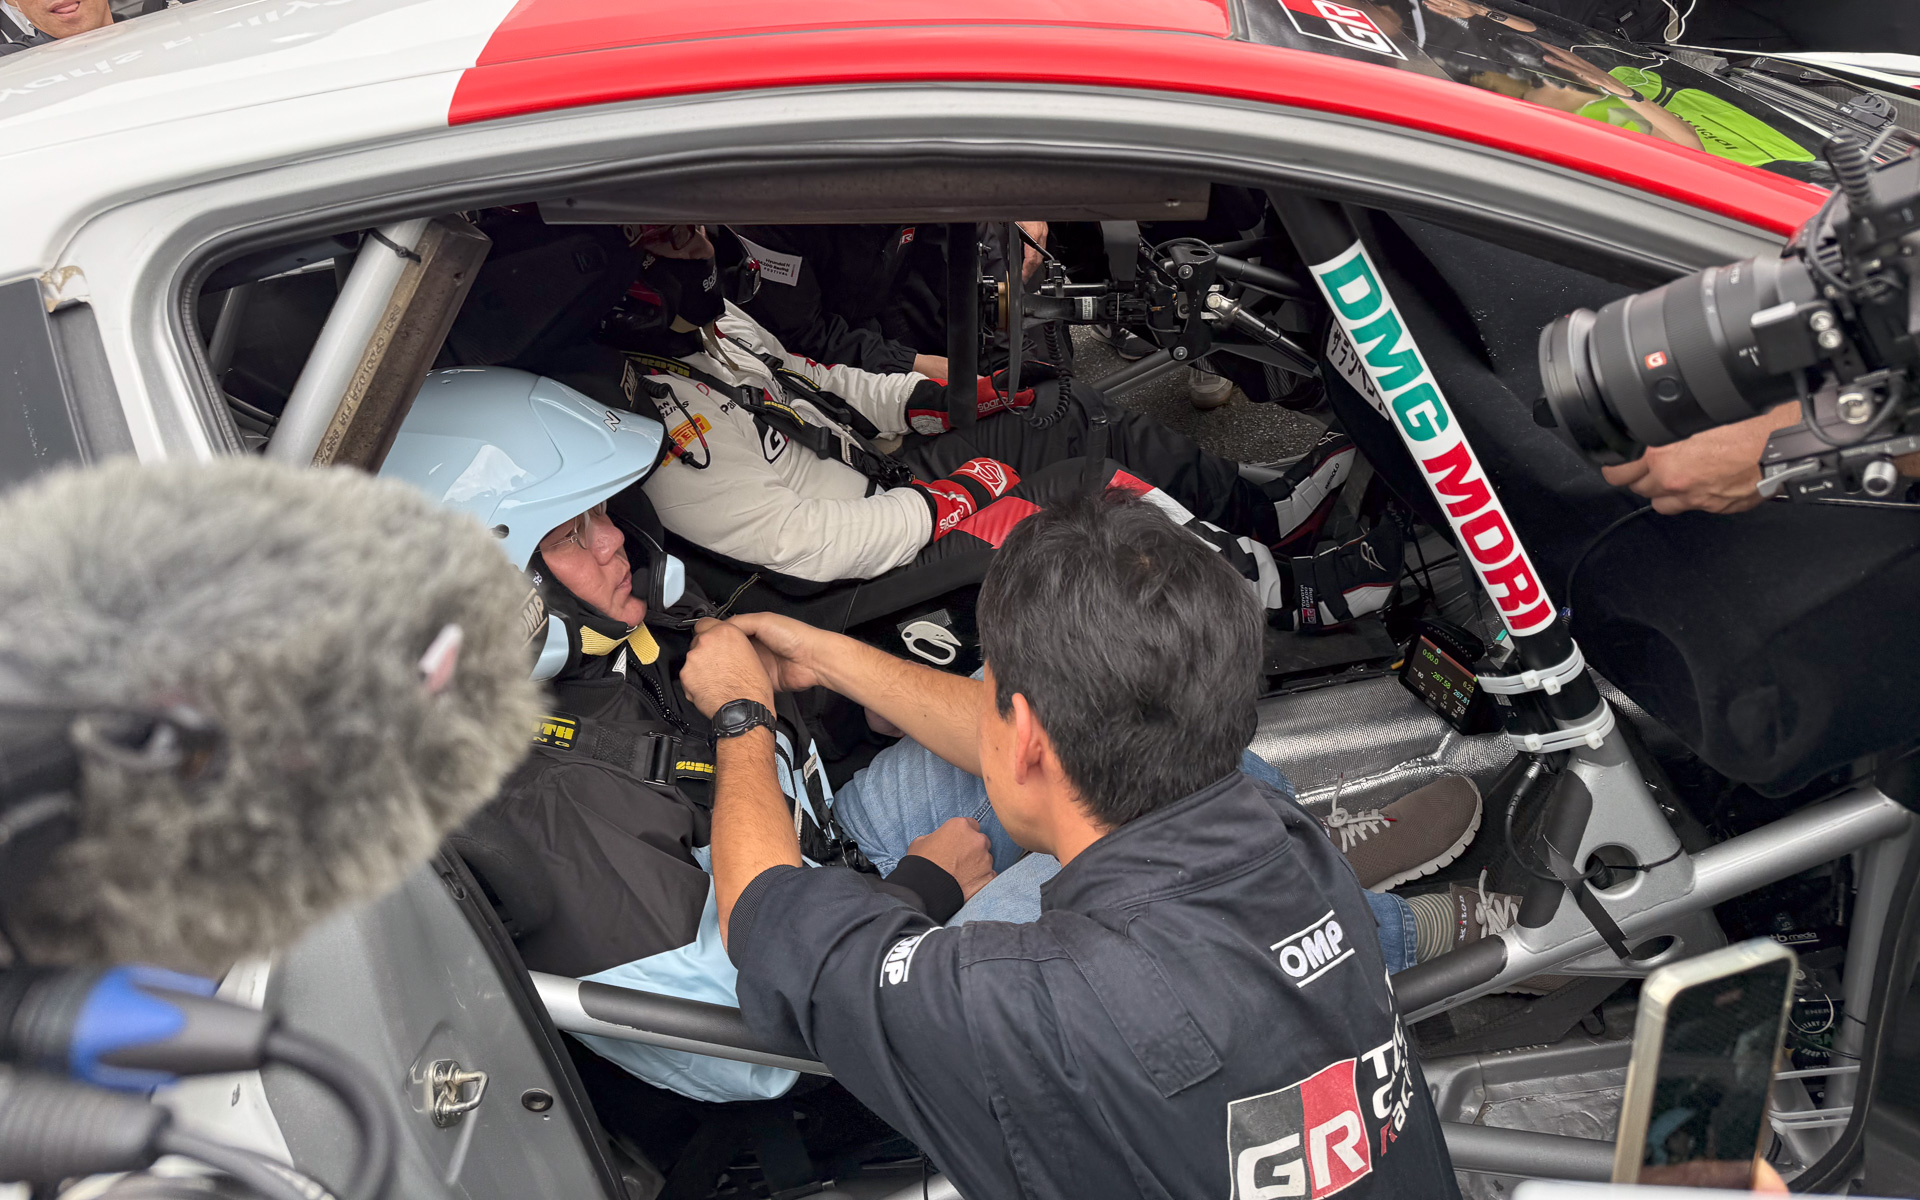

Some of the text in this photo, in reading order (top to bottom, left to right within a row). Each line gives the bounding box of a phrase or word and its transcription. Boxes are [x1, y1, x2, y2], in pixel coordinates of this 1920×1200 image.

[1319, 250, 1551, 630] DMG MORI
[884, 936, 920, 985] MP
[1279, 921, 1345, 979] OMP
[1236, 1109, 1367, 1200] GR
